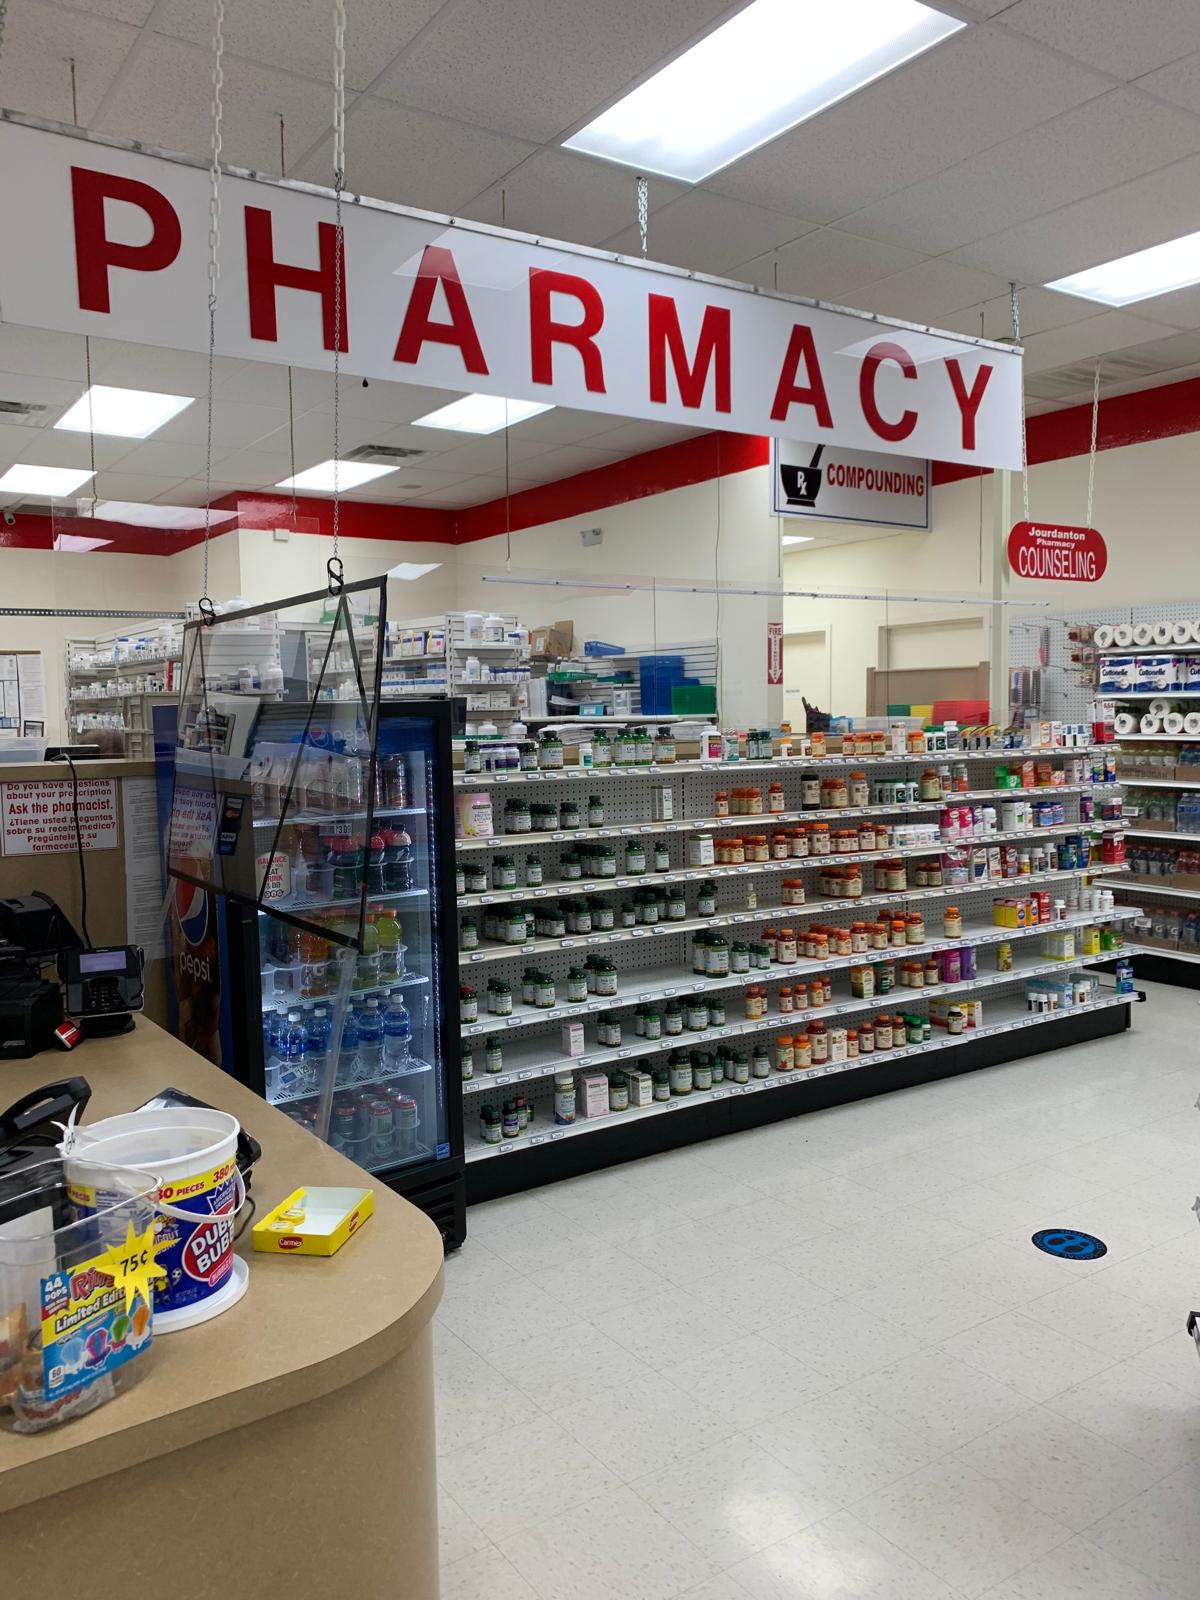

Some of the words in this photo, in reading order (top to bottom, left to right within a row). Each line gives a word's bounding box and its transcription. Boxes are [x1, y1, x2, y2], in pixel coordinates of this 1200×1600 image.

[71, 166, 993, 450] PHARMACY
[827, 463, 924, 496] COMPOUNDING
[1029, 527, 1086, 541] Jourdanton
[1036, 538, 1076, 550] Pharmacy
[1018, 546, 1097, 580] COUNSELING
[769, 627, 782, 636] FIRE
[1102, 668, 1128, 677] Cottonelle
[1138, 668, 1165, 677] Cottonelle
[7, 783, 20, 791] Do
[23, 783, 39, 791] you
[42, 781, 64, 789] have
[67, 780, 110, 790] qestions
[7, 792, 33, 800] about
[36, 791, 56, 799] your
[59, 789, 112, 798] precription
[9, 803, 28, 815] Ask
[31, 802, 48, 813] the
[9, 818, 39, 827] ¿Tiene
[43, 816, 67, 824] usted
[70, 814, 113, 824] peguntas
[7, 827, 32, 836] sobre
[80, 822, 116, 831] medica?
[32, 841, 94, 851] farmaceutco.
[180, 951, 211, 982] pepsi
[176, 1181, 205, 1197] PIECES
[212, 1164, 230, 1183] 380
[120, 1250, 148, 1276] 75¢
[45, 1276, 62, 1293] 44
[45, 1286, 68, 1302] POPS
[55, 1296, 100, 1335] Limited
